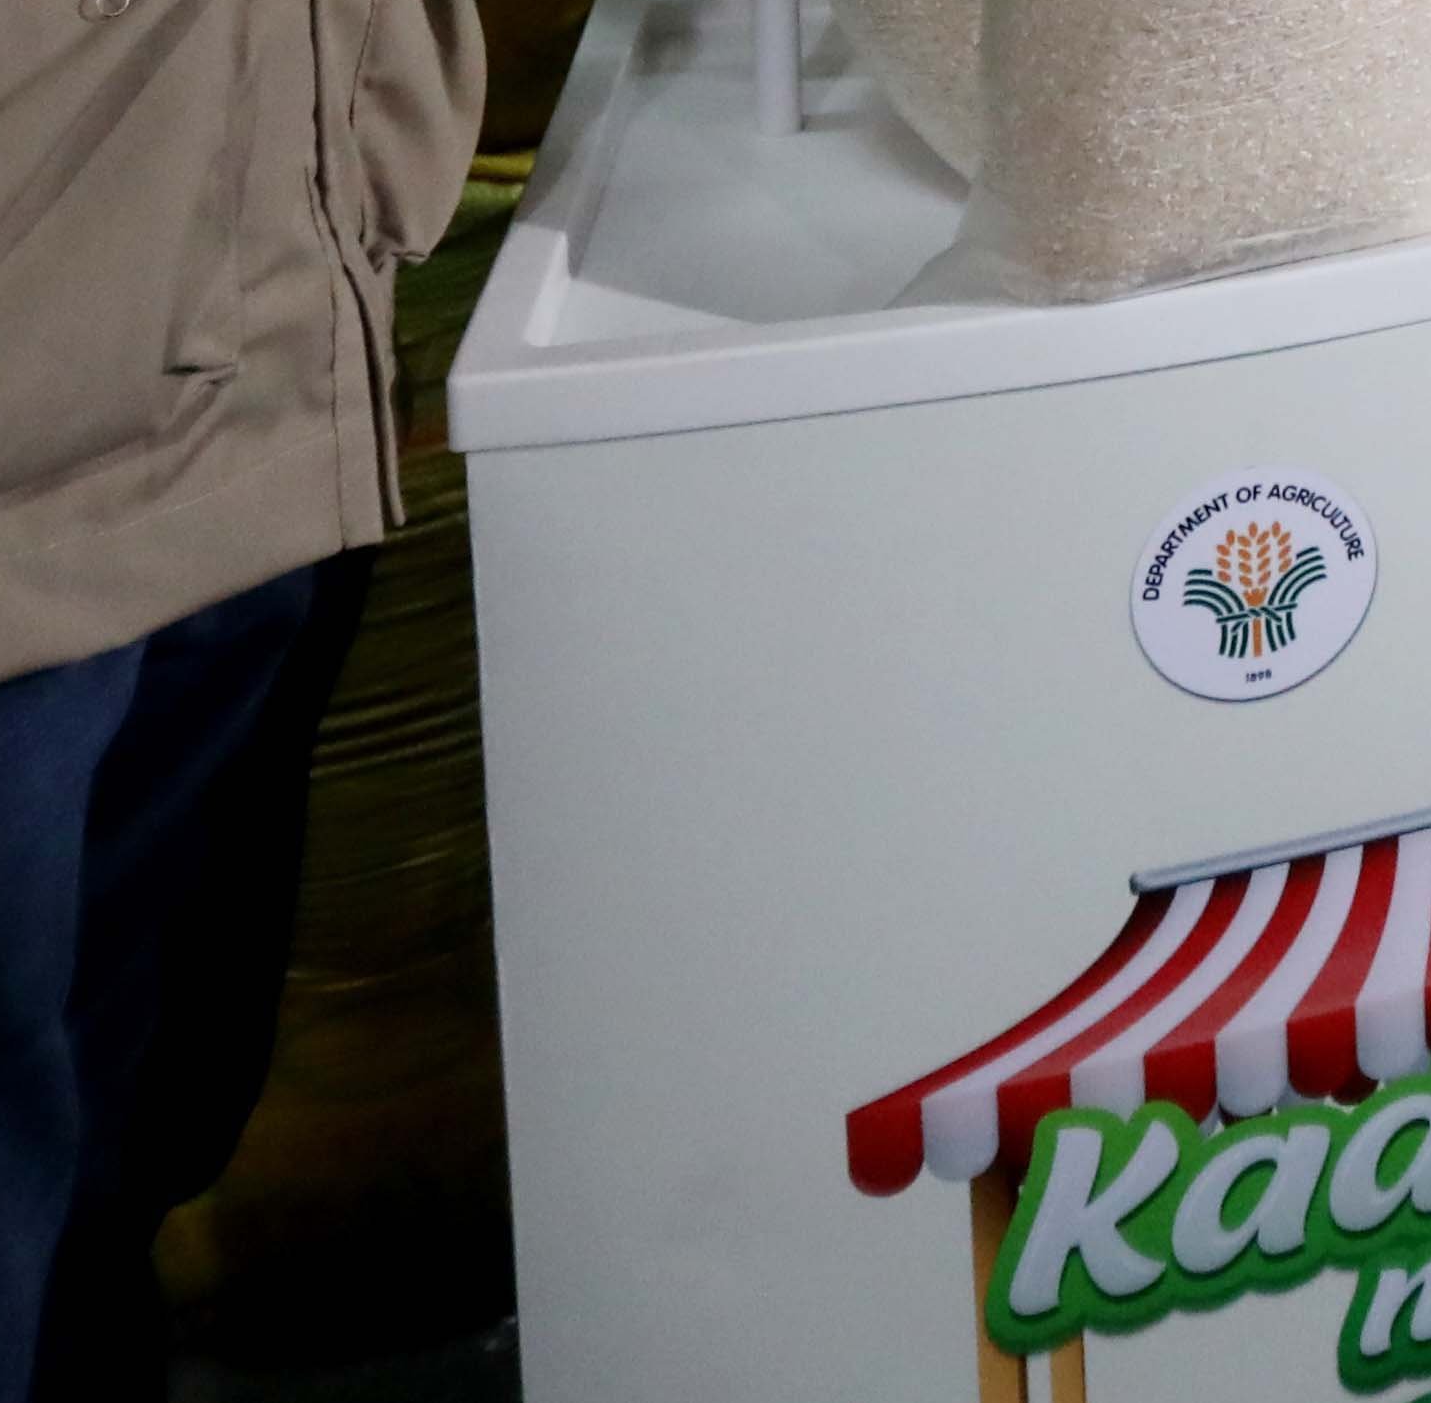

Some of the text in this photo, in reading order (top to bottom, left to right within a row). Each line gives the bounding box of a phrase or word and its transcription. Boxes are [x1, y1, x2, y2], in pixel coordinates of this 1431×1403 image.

[1142, 483, 1365, 602] DEPARTMENT OF AGRICULTURE
